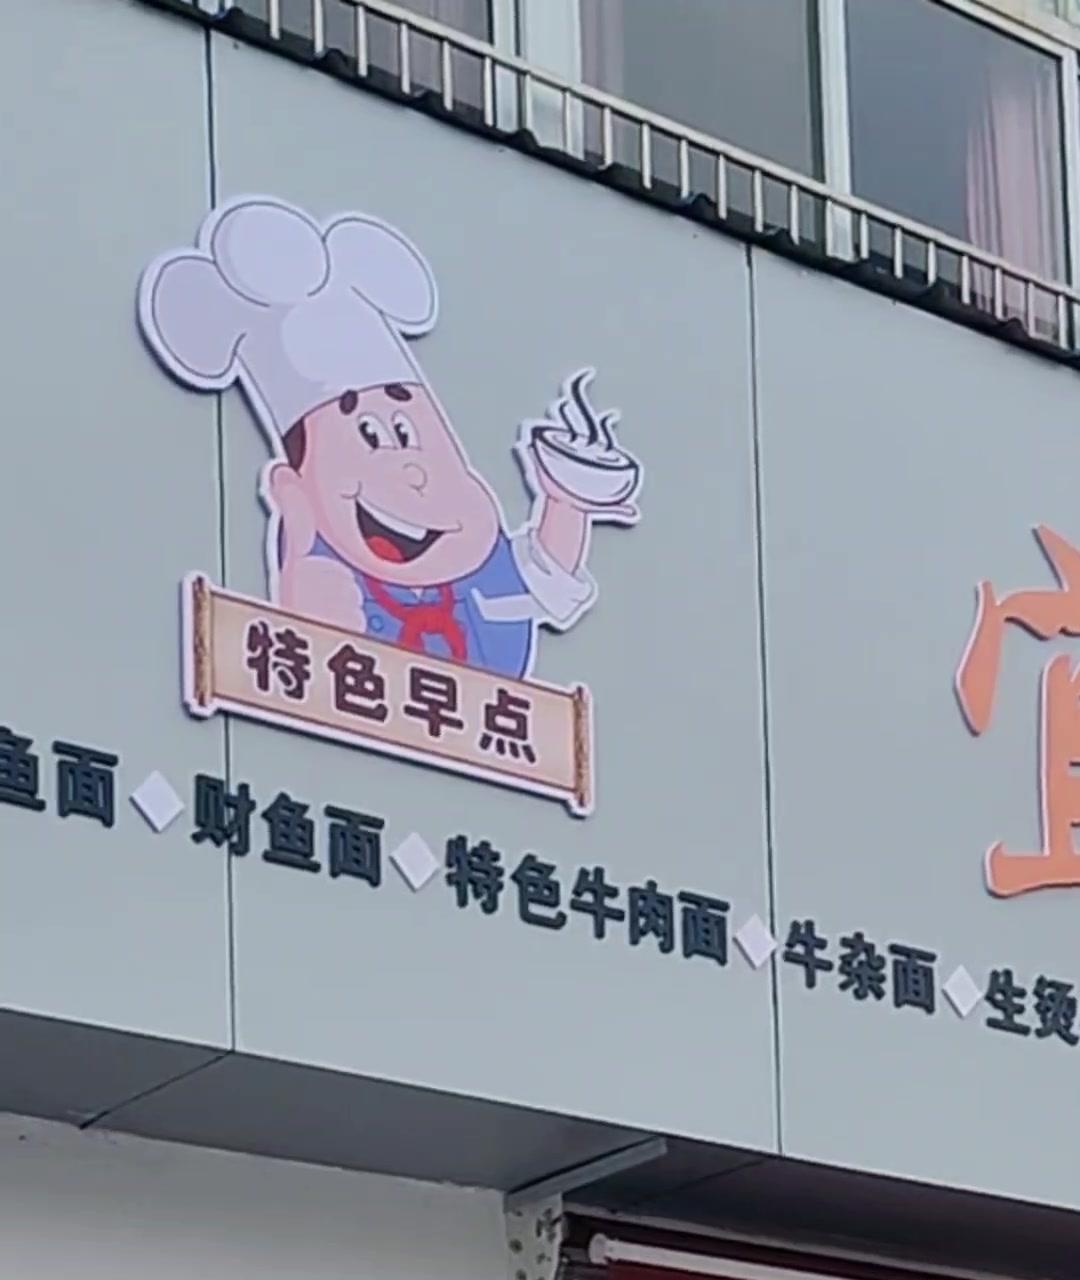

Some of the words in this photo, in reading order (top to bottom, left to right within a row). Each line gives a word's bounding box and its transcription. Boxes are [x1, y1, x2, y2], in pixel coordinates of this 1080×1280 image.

[246, 620, 538, 765] 特色早点
[0, 725, 118, 829] 鱼面
[191, 773, 385, 888] 财鱼面
[445, 834, 730, 967] 特色牛肉面
[782, 919, 937, 1015] 牛杂面
